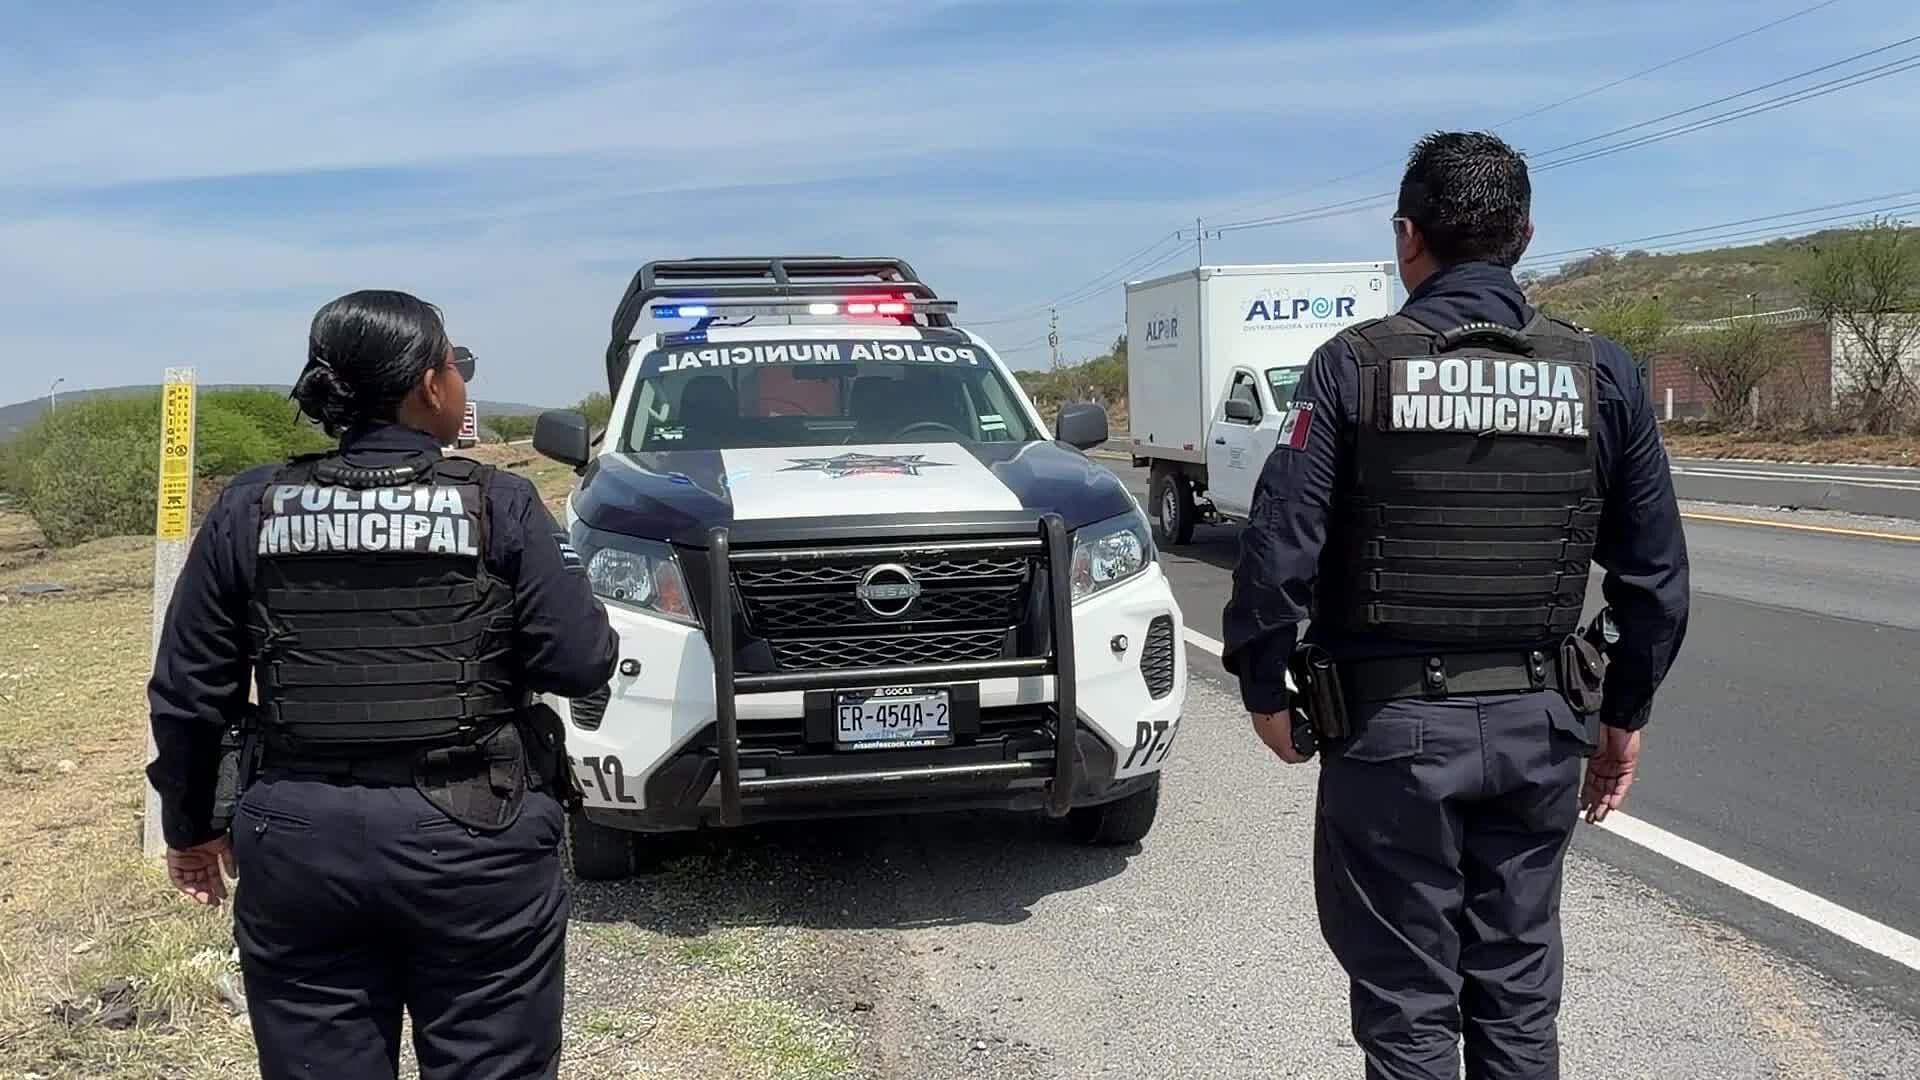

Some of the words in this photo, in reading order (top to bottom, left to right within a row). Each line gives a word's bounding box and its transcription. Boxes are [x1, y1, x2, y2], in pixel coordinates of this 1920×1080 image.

[1245, 296, 1357, 321] ALPOR
[1146, 318, 1178, 342] ALPOR
[166, 389, 177, 455] PELIGRO
[1392, 394, 1590, 437] MUNICIPAL
[258, 513, 479, 557] MUNICIPAL
[857, 586, 918, 599] NISSAN
[840, 702, 949, 732] ER-454A-2
